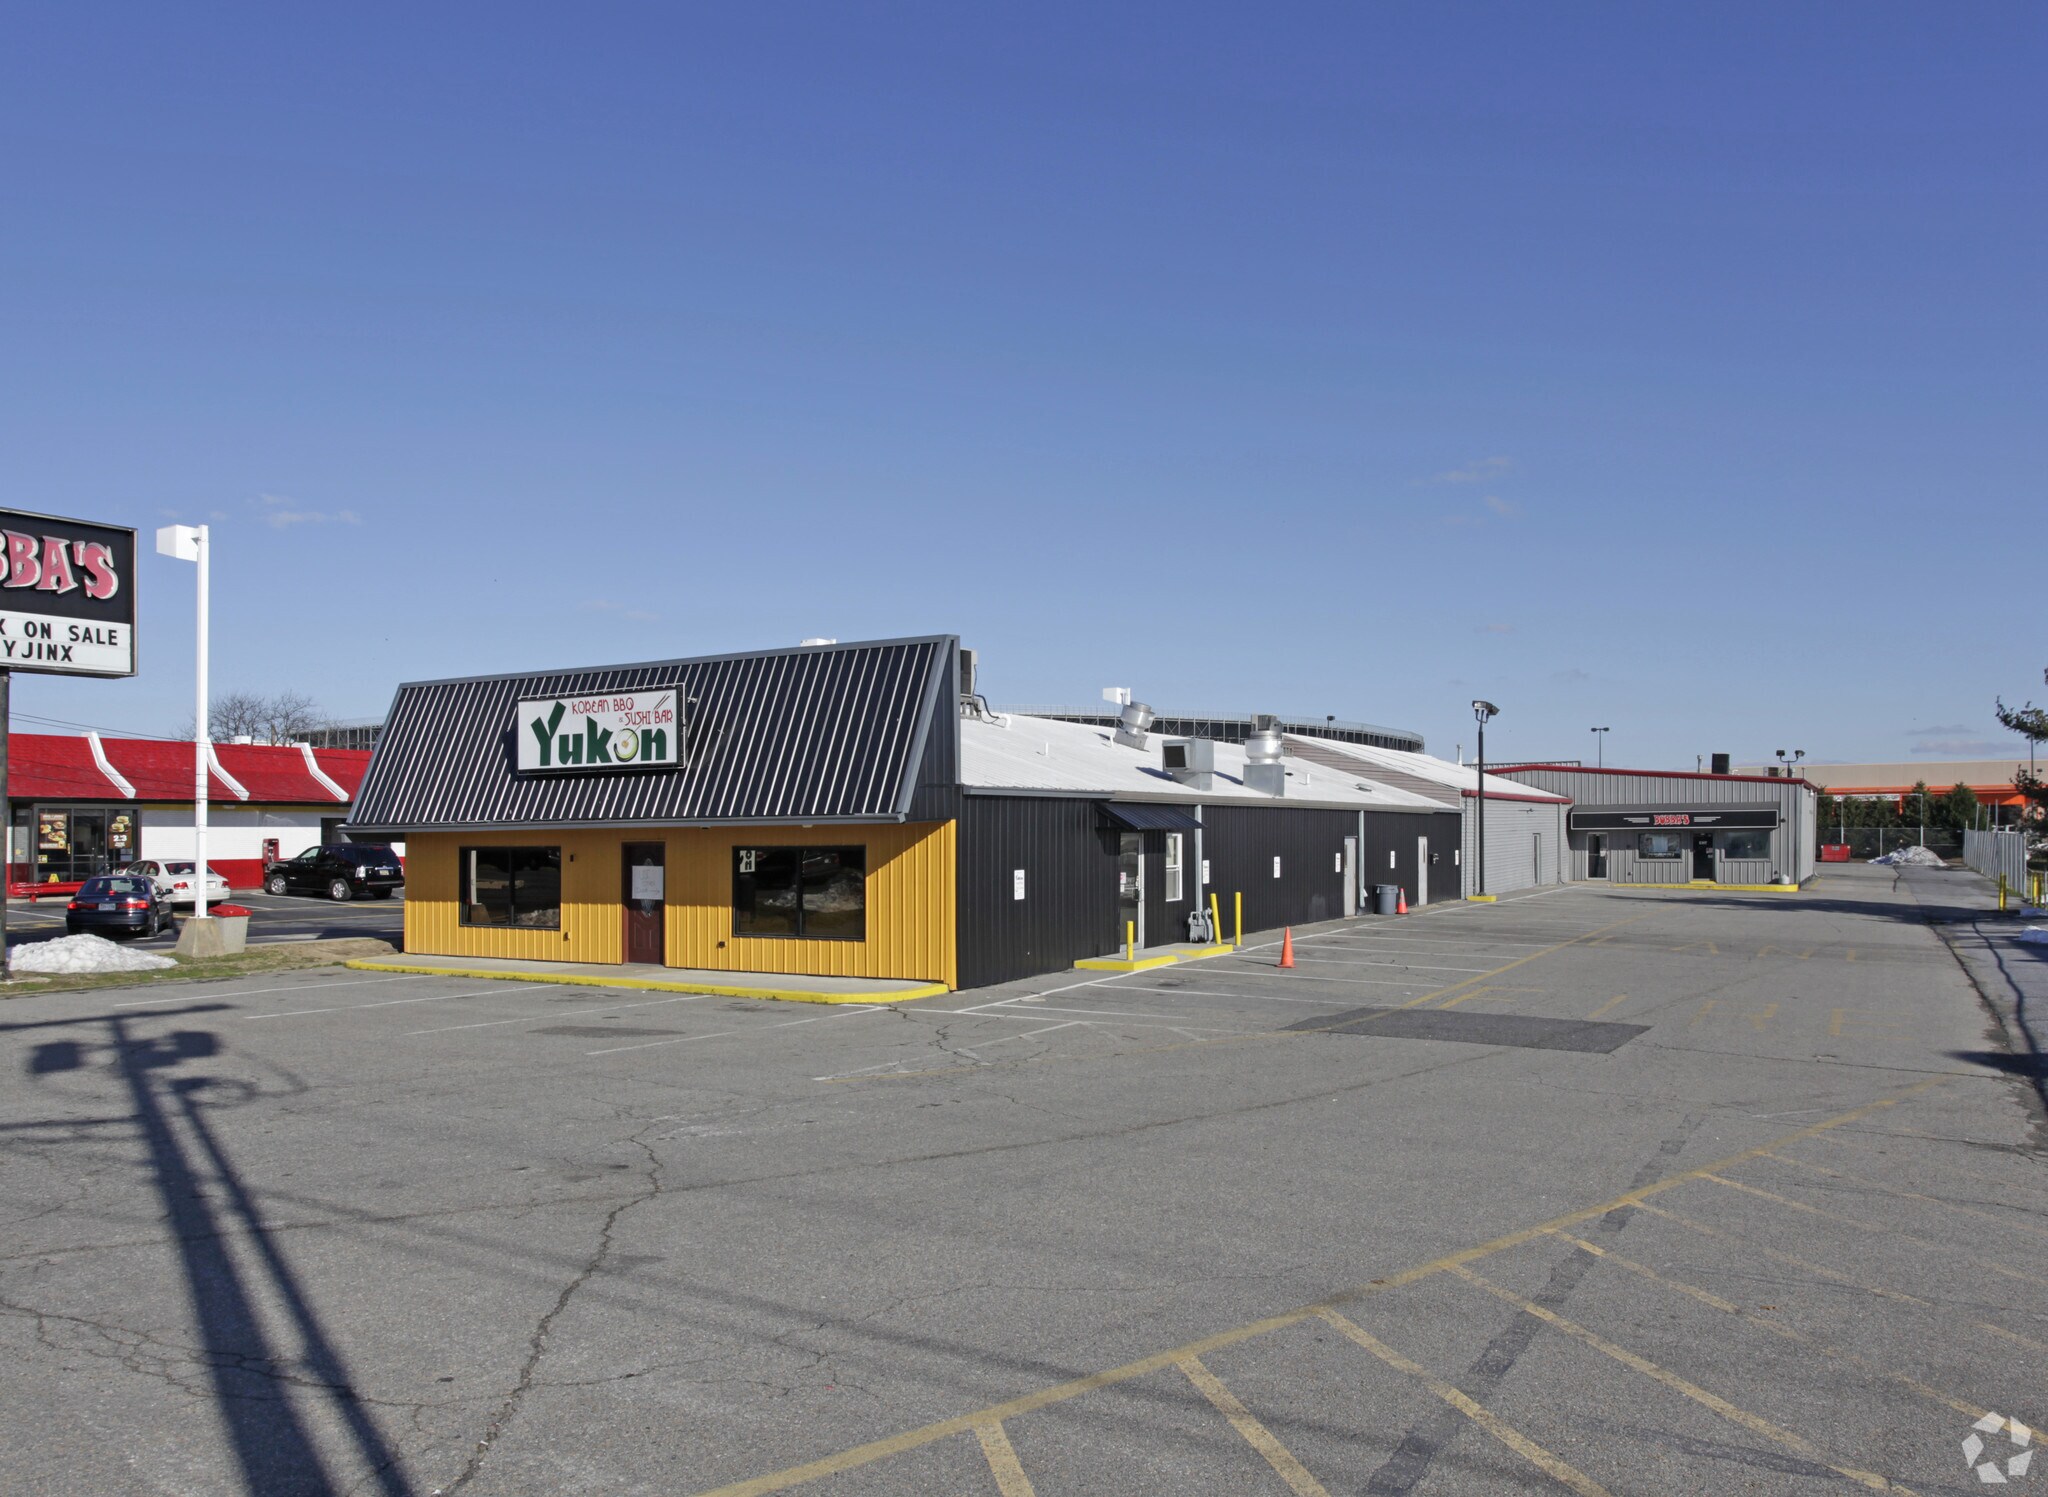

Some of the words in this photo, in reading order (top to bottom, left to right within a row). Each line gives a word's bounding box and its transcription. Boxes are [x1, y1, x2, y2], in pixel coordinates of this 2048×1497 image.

[0, 529, 119, 600] BA'S
[24, 621, 52, 640] ON
[68, 625, 118, 646] SALE
[571, 698, 610, 715] KOREAN
[613, 697, 635, 712] BBQ
[625, 710, 652, 726] SUSHI
[654, 709, 673, 725] BAR
[530, 700, 667, 767] Yukon
